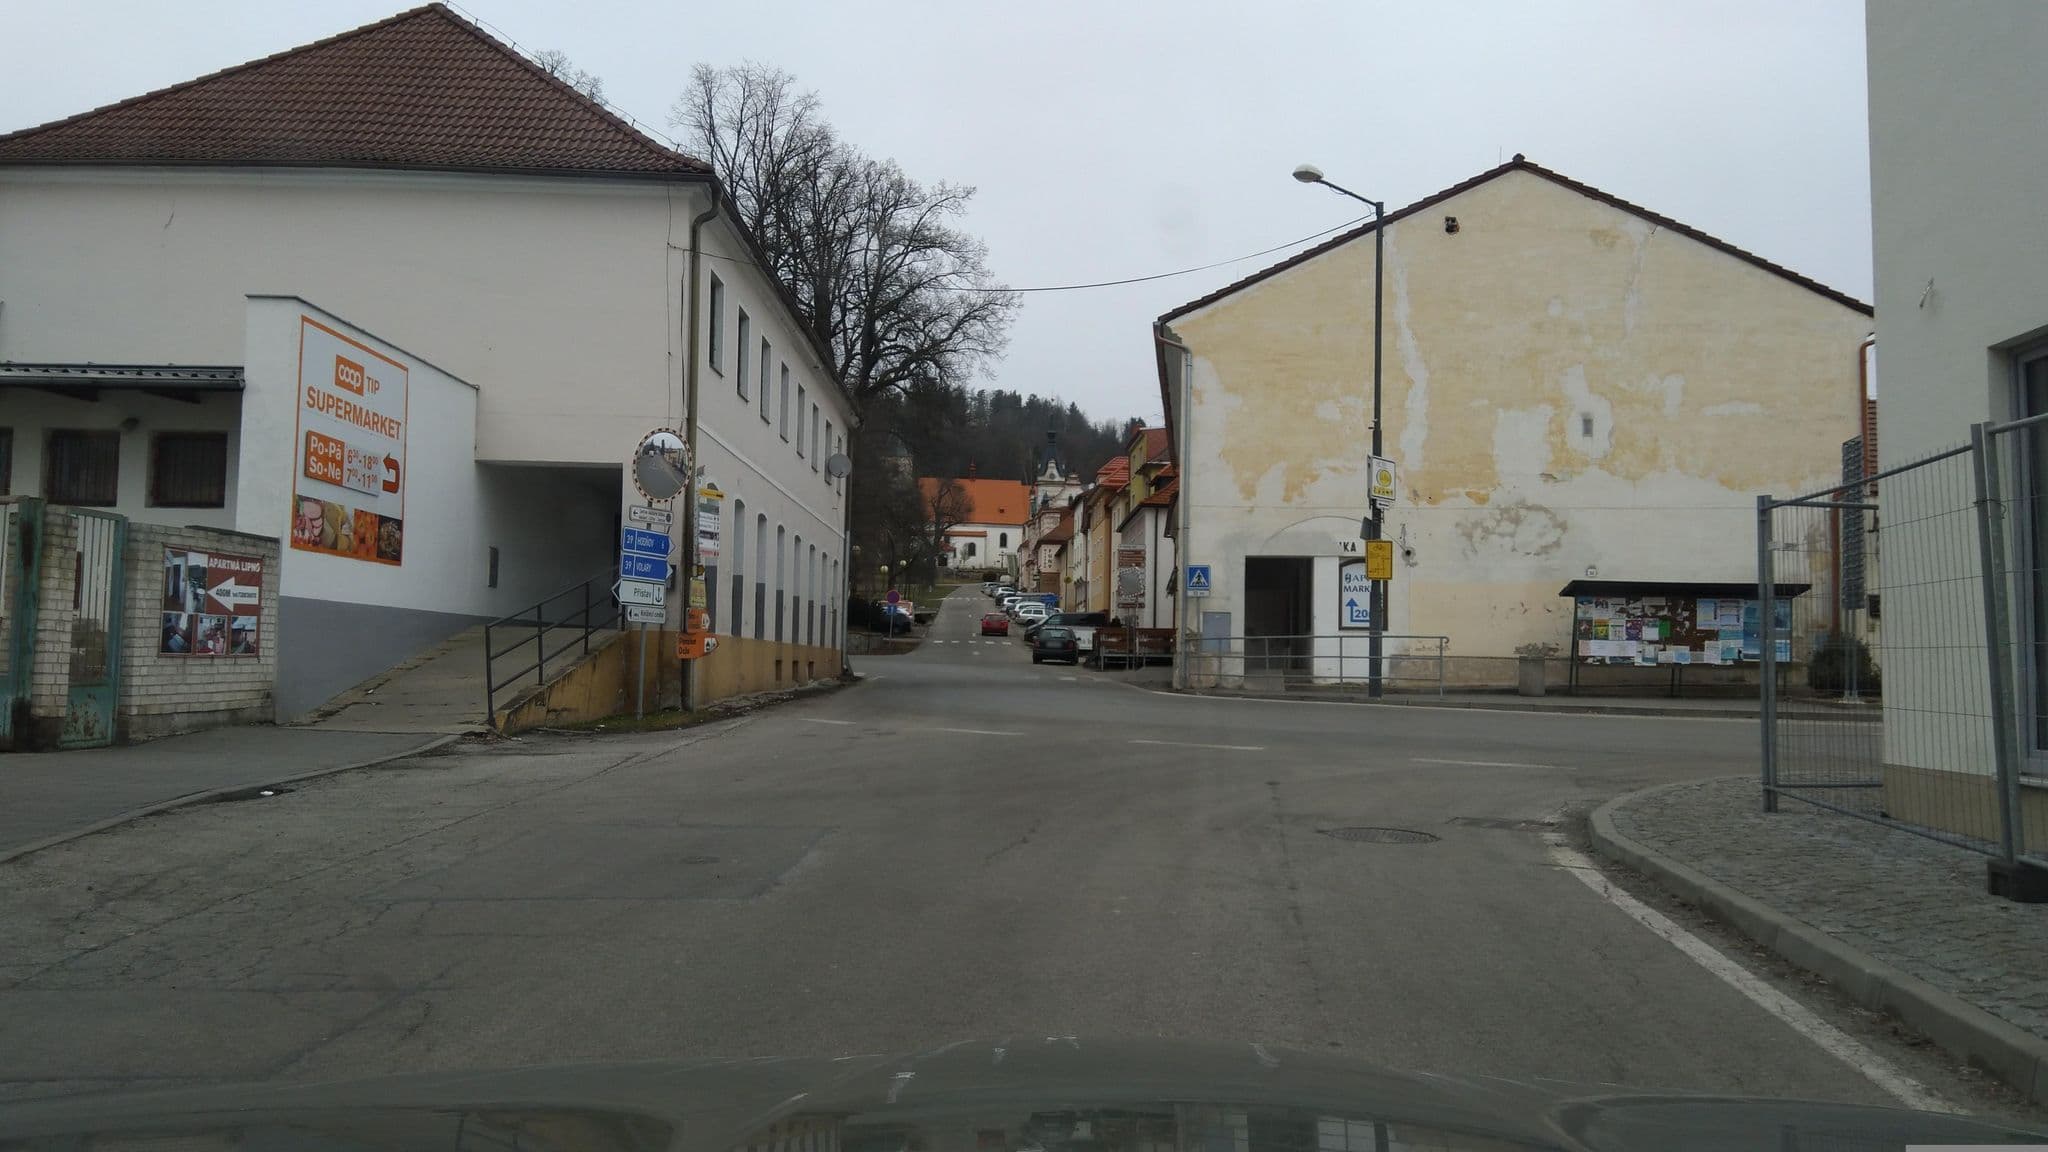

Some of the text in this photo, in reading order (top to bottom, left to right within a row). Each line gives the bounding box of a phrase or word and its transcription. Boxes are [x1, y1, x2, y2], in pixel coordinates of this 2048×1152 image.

[366, 375, 380, 395] TIP
[306, 385, 401, 440] SUPERMARKET
[1343, 585, 1370, 593] MARK
